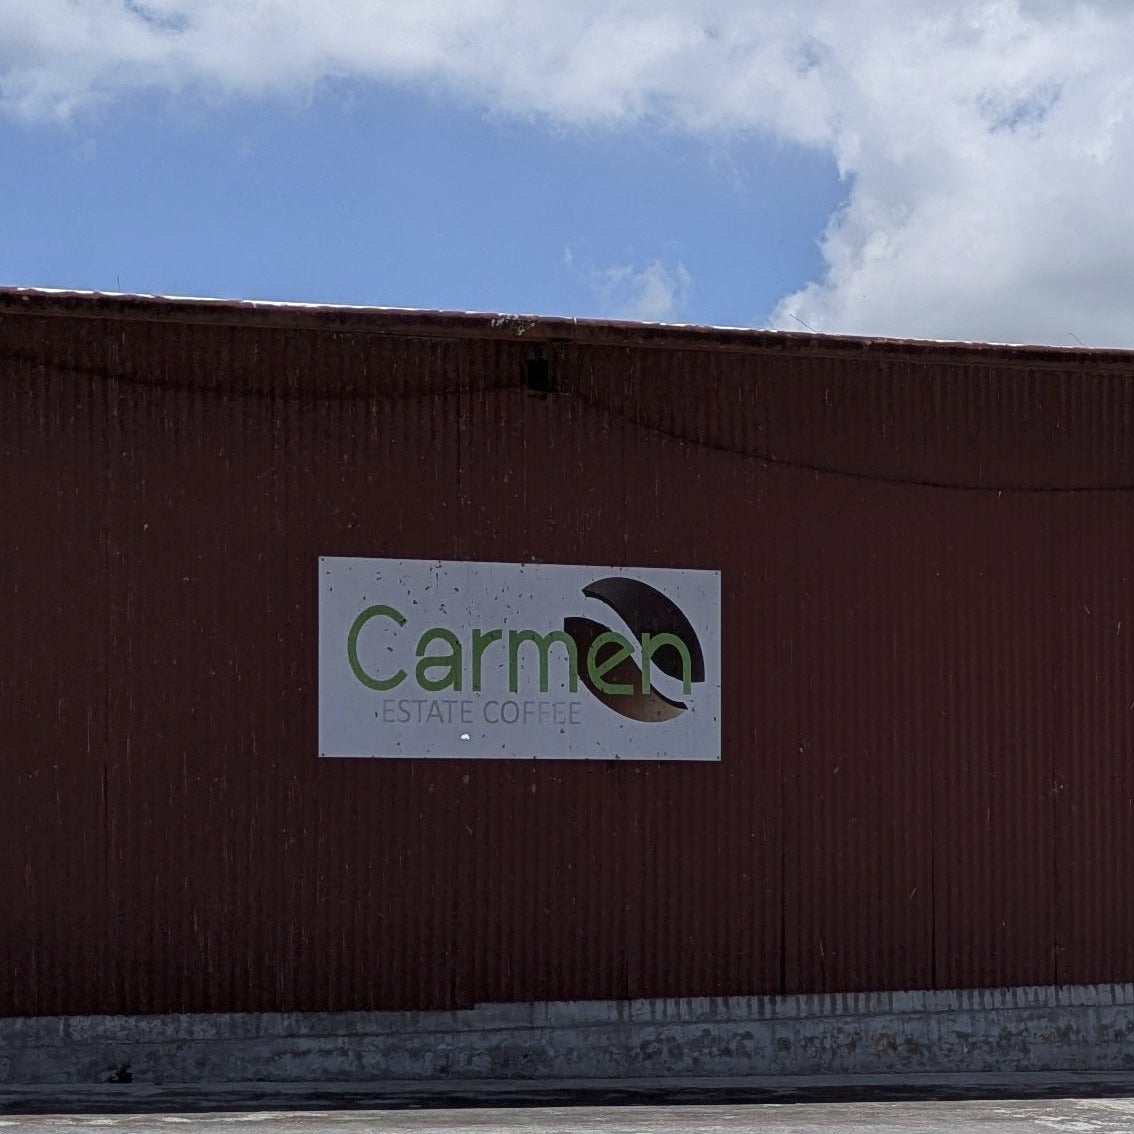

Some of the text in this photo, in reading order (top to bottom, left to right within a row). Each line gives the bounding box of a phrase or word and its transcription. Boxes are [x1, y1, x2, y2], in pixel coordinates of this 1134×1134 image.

[347, 604, 692, 695] Carmen
[382, 699, 582, 726] ESTATE COFFEE
